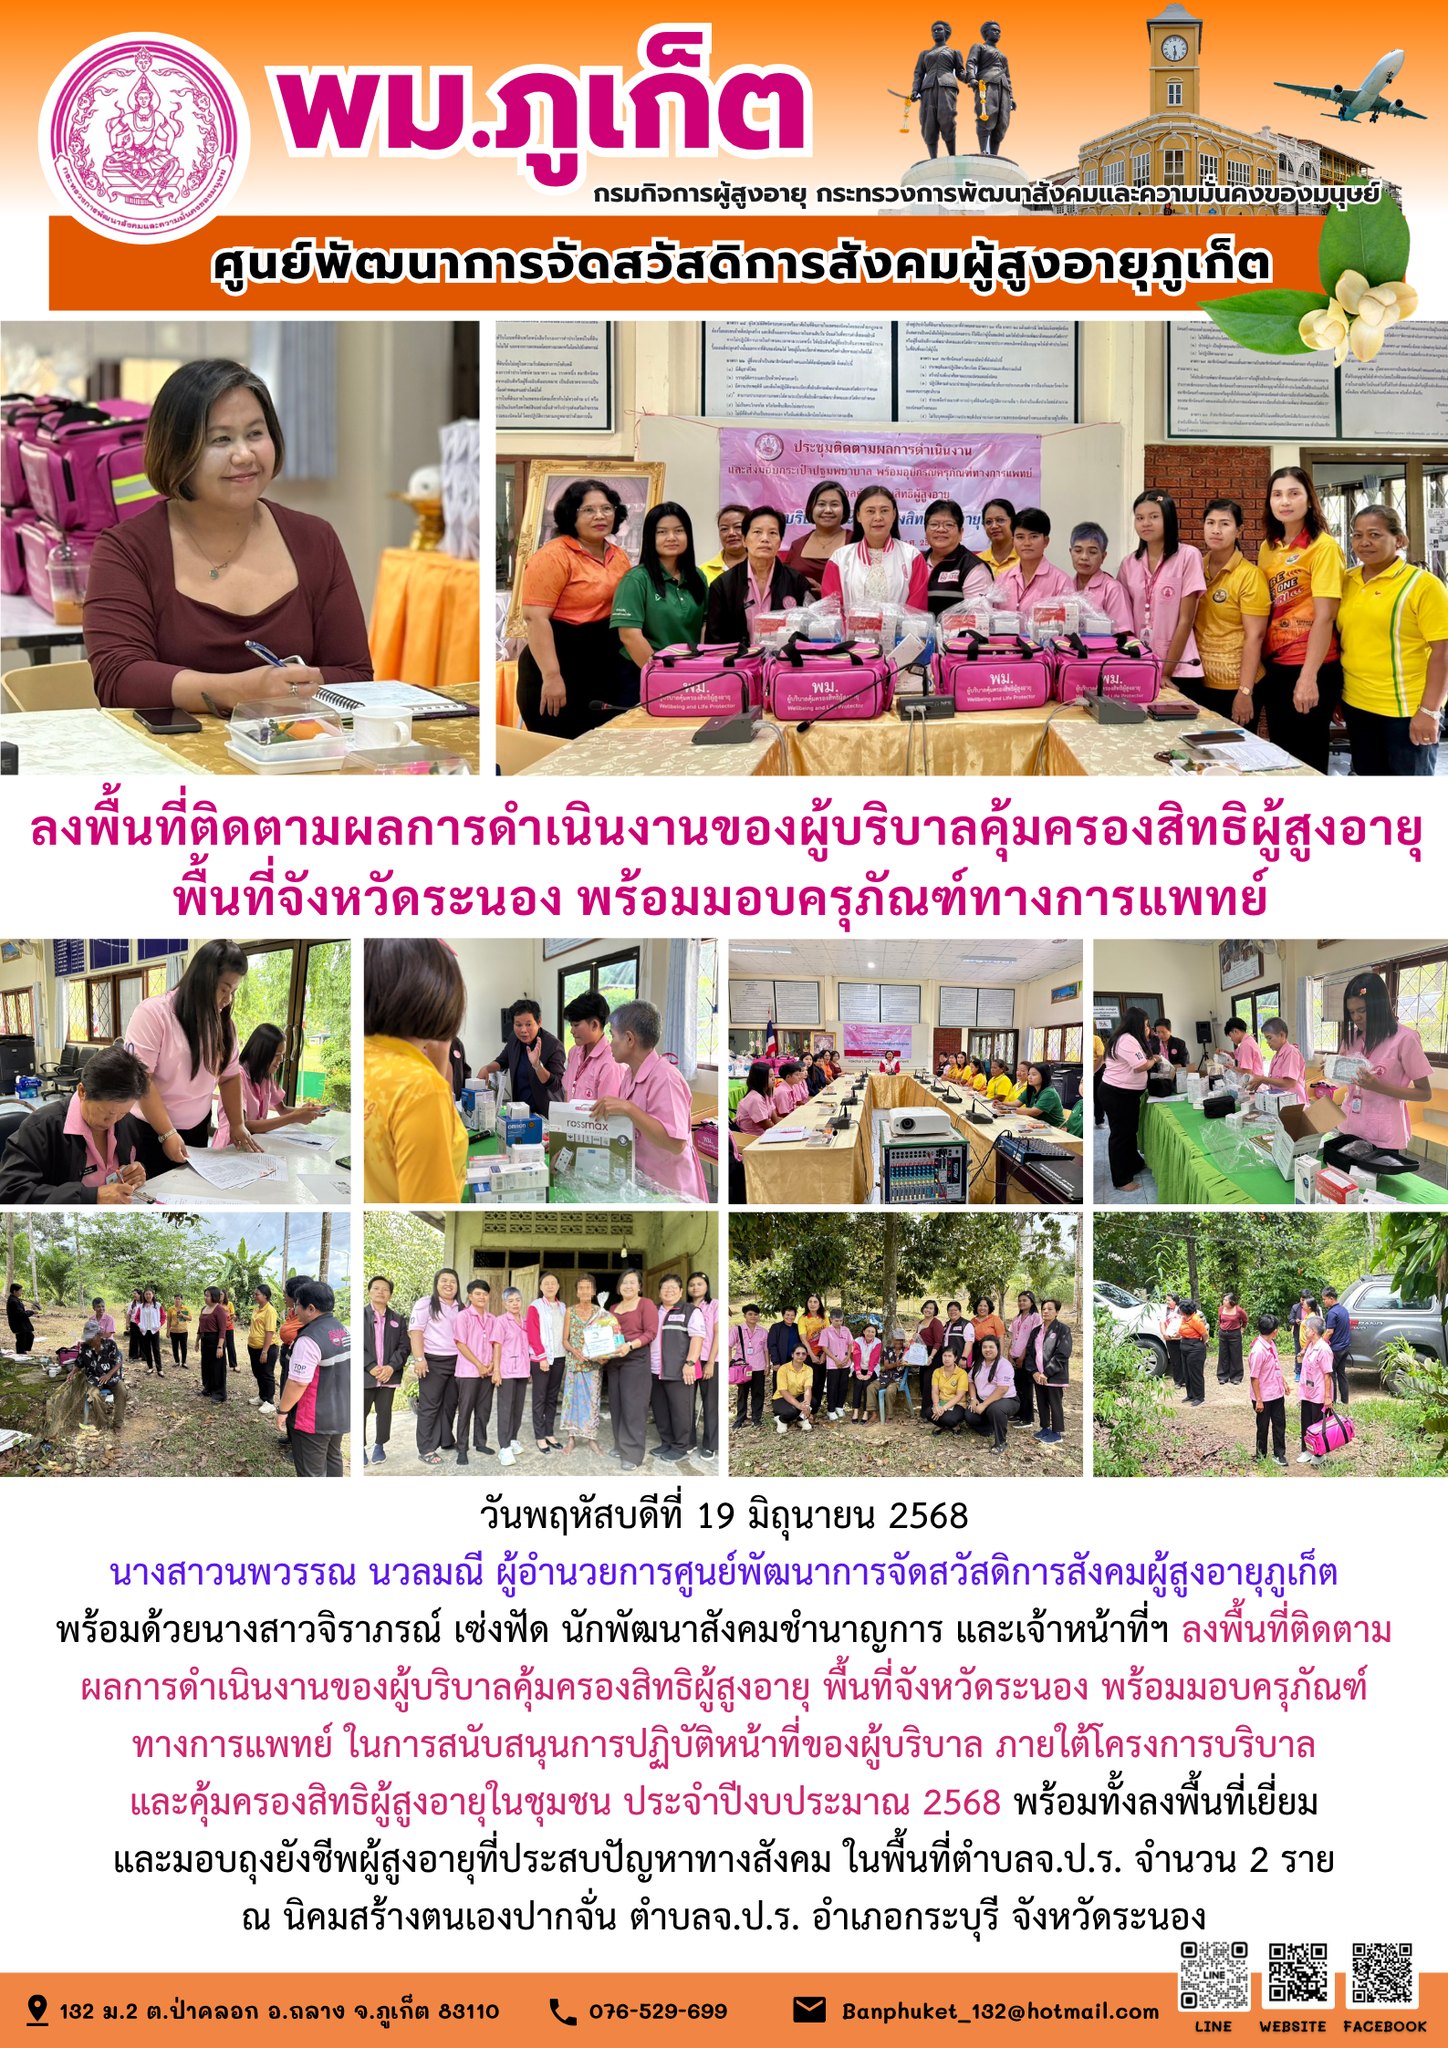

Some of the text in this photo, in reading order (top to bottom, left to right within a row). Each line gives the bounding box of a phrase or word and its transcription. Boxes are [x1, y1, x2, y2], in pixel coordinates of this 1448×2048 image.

[793, 440, 973, 458] ประชุมติดตามผลการดำเนินงาน
[989, 673, 1013, 685] พม.
[812, 682, 839, 694] พม.
[566, 1119, 609, 1132] rossmax
